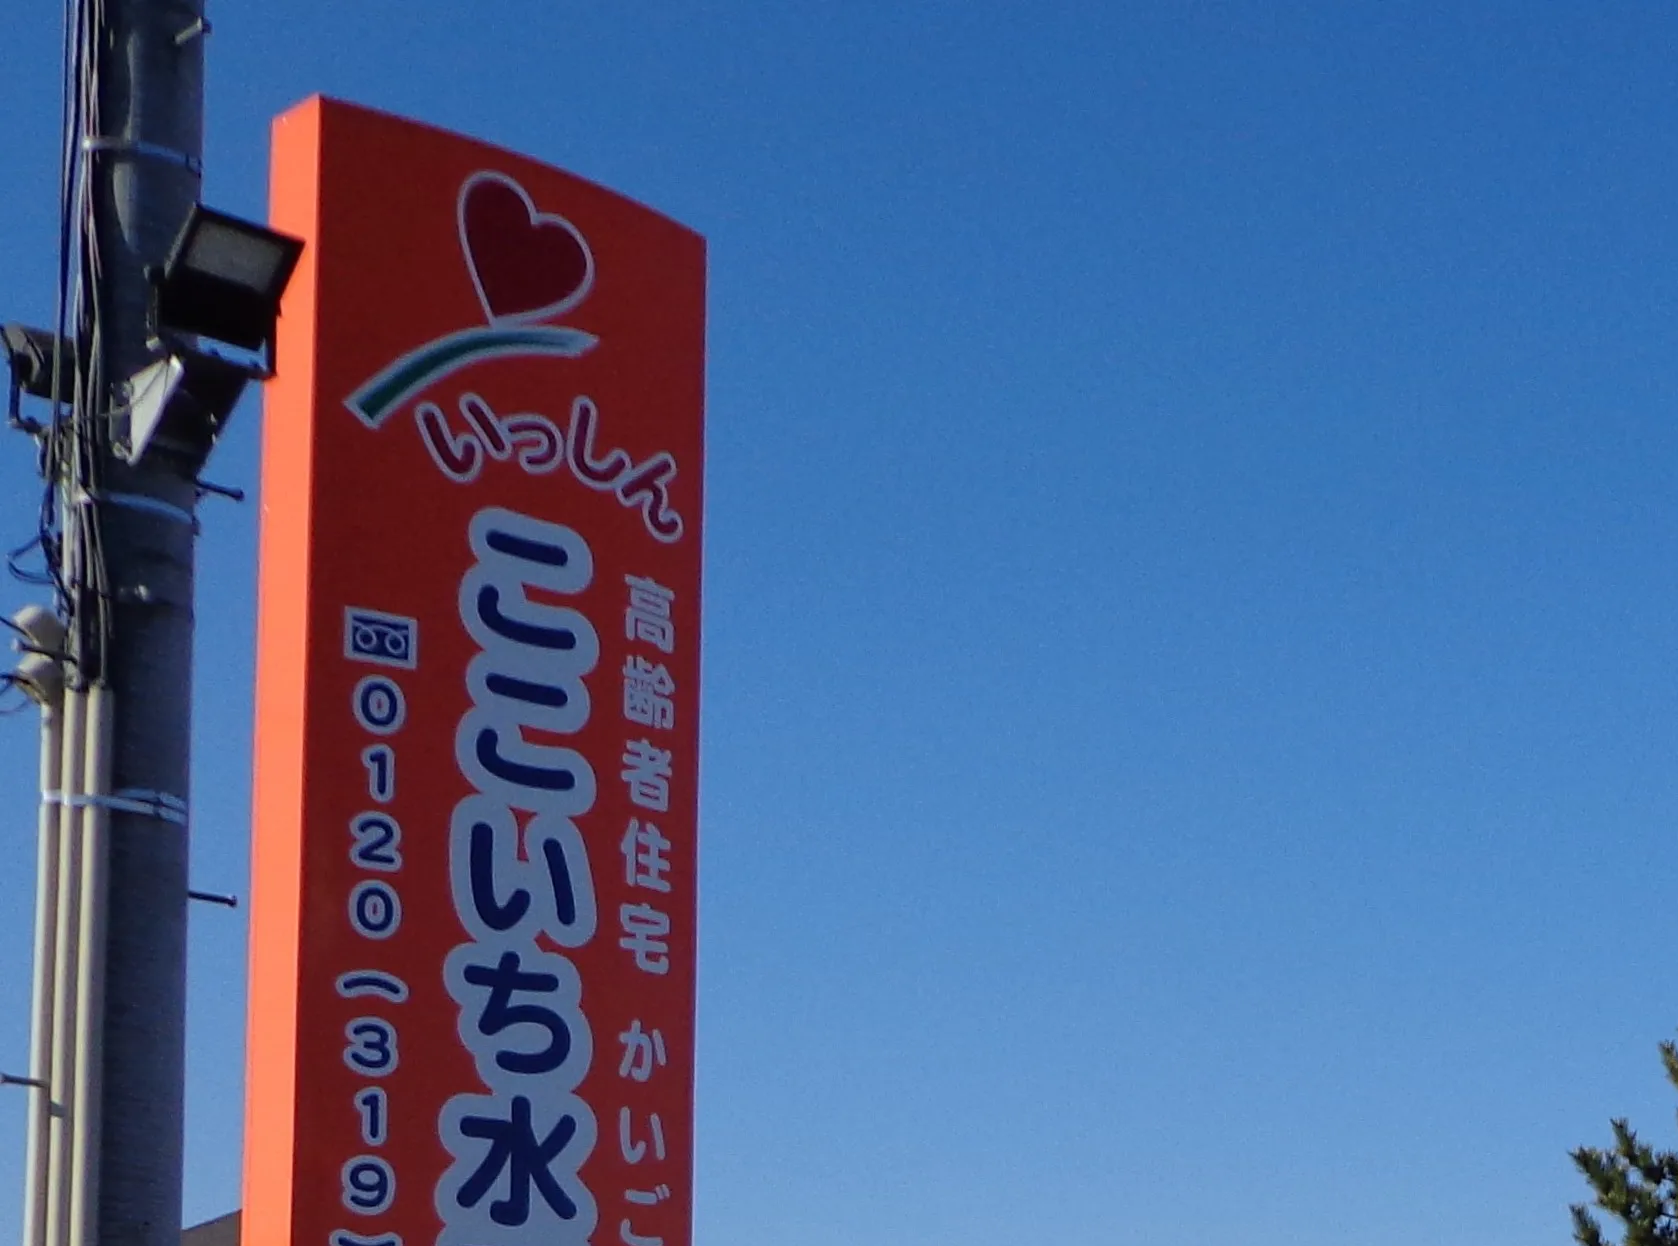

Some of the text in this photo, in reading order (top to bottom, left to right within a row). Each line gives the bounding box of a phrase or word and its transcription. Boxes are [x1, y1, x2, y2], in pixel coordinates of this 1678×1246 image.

[415, 394, 684, 543] いっしん
[618, 574, 676, 976] 高齢者住宅
